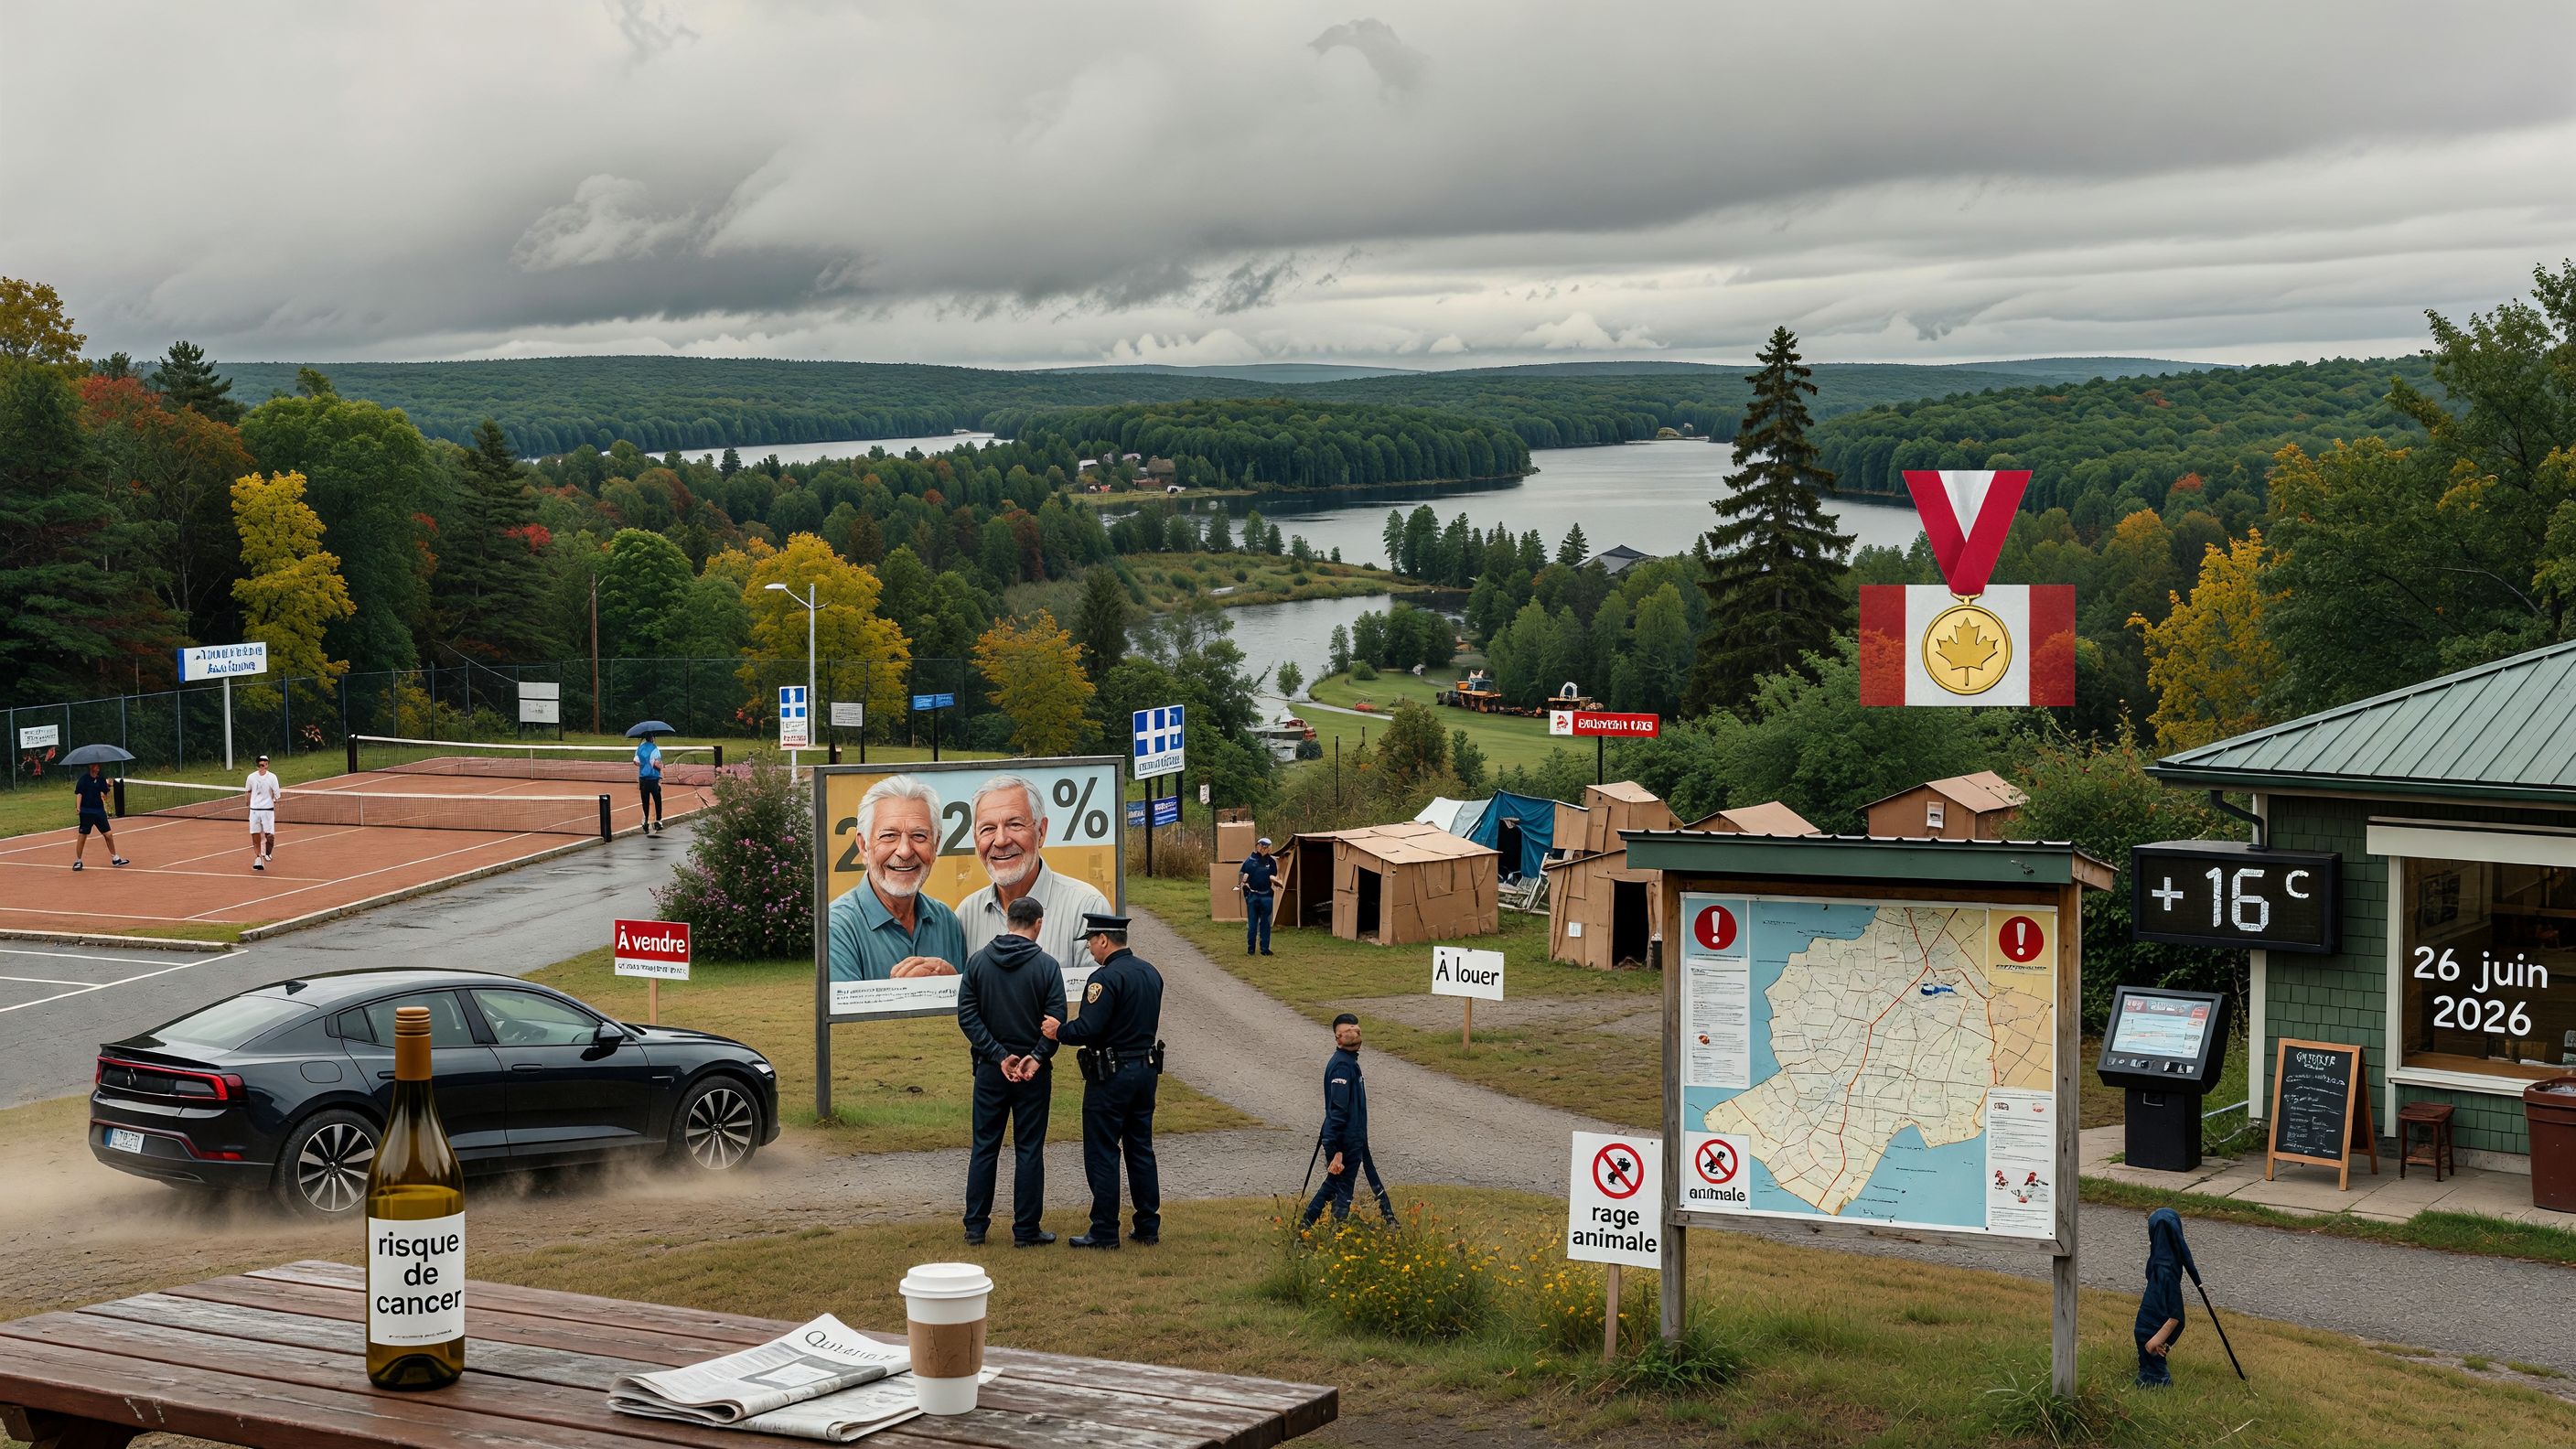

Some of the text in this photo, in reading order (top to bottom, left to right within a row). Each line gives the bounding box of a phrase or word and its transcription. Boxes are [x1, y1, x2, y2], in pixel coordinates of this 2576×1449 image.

[1053, 777, 1109, 842] %
[632, 930, 686, 953] vendre
[1456, 956, 1499, 986] louer
[2414, 946, 2548, 993] 26 juin
[2433, 995, 2532, 1036] 2026
[1592, 1206, 1639, 1230] rage
[378, 1231, 459, 1262] risque
[1572, 1227, 1658, 1253] animale
[403, 1261, 439, 1286] de
[376, 1290, 462, 1315] cancer
